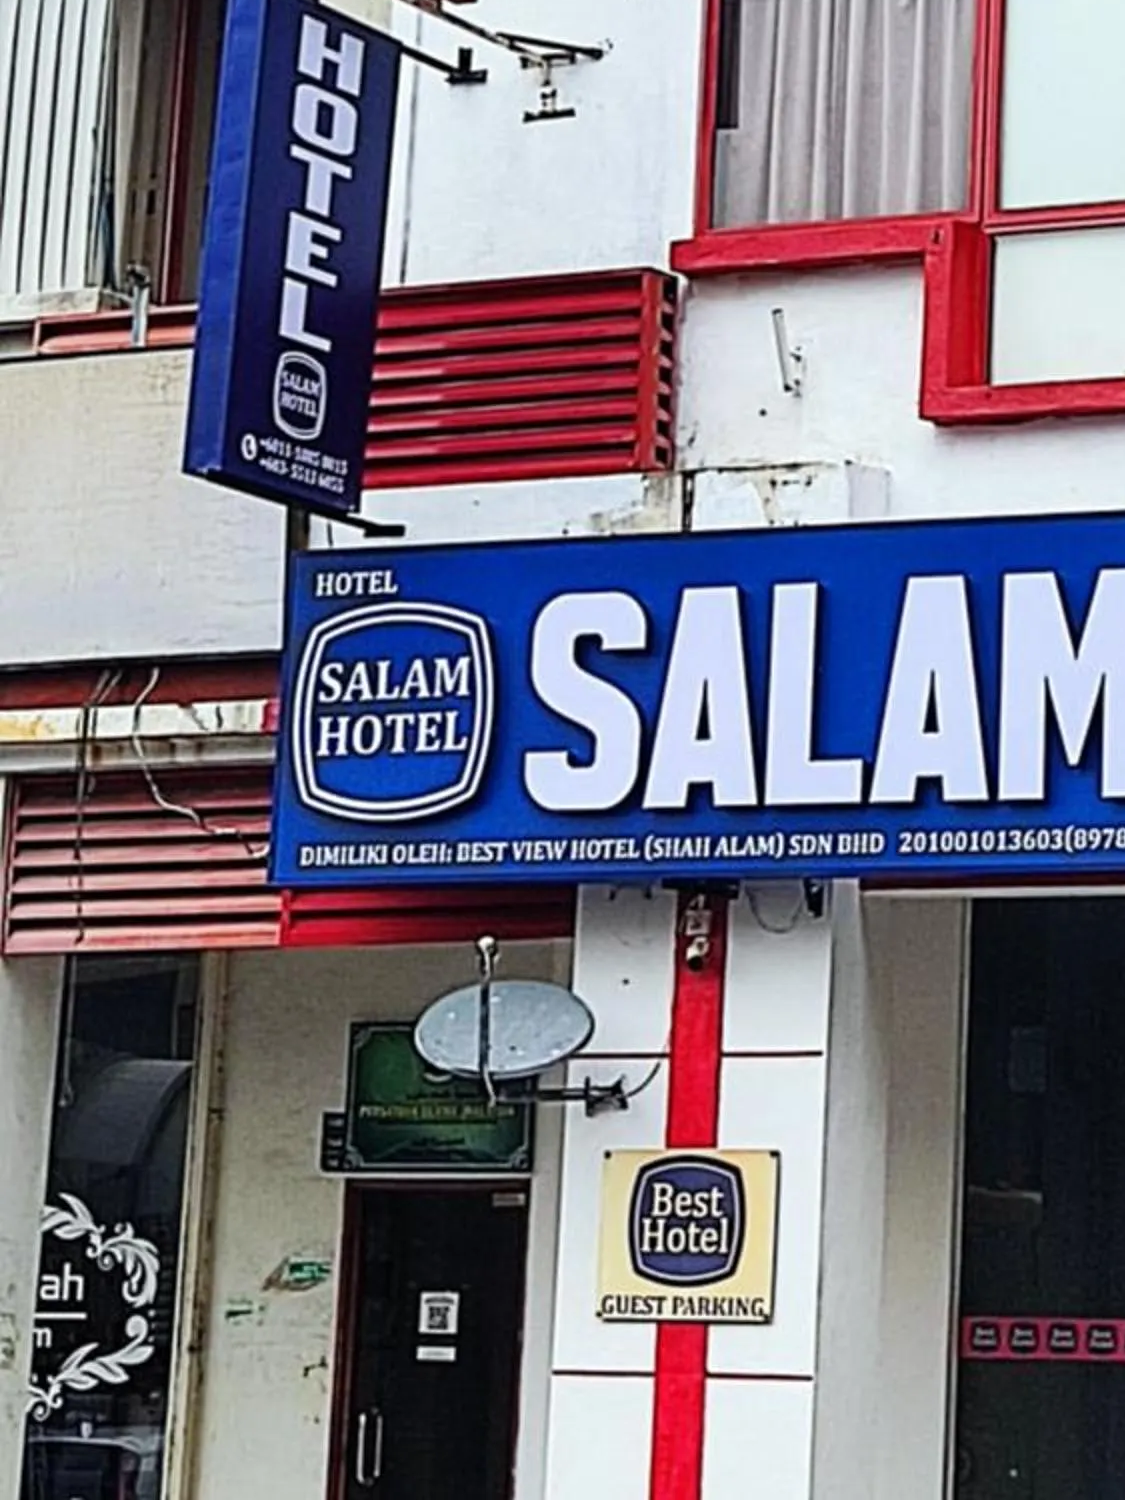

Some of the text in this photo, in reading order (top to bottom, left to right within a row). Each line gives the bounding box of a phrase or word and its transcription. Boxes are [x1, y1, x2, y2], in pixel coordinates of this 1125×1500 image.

[278, 14, 366, 352] HOTEL
[315, 569, 398, 597] HOTEL
[317, 656, 472, 703] SALAM
[316, 710, 469, 757] HOTEL
[300, 844, 388, 867] DIMILIKI
[456, 841, 508, 863] BEST
[512, 840, 566, 861] VIEW
[570, 837, 640, 860] HOTEL
[644, 835, 710, 860] (SHAH
[714, 832, 784, 859] ALAM)
[788, 833, 833, 855] SDN
[837, 832, 885, 855] BHD
[651, 1182, 725, 1217] Best
[640, 1217, 729, 1255] Hotel
[601, 1296, 767, 1316] GUEST PARKING
